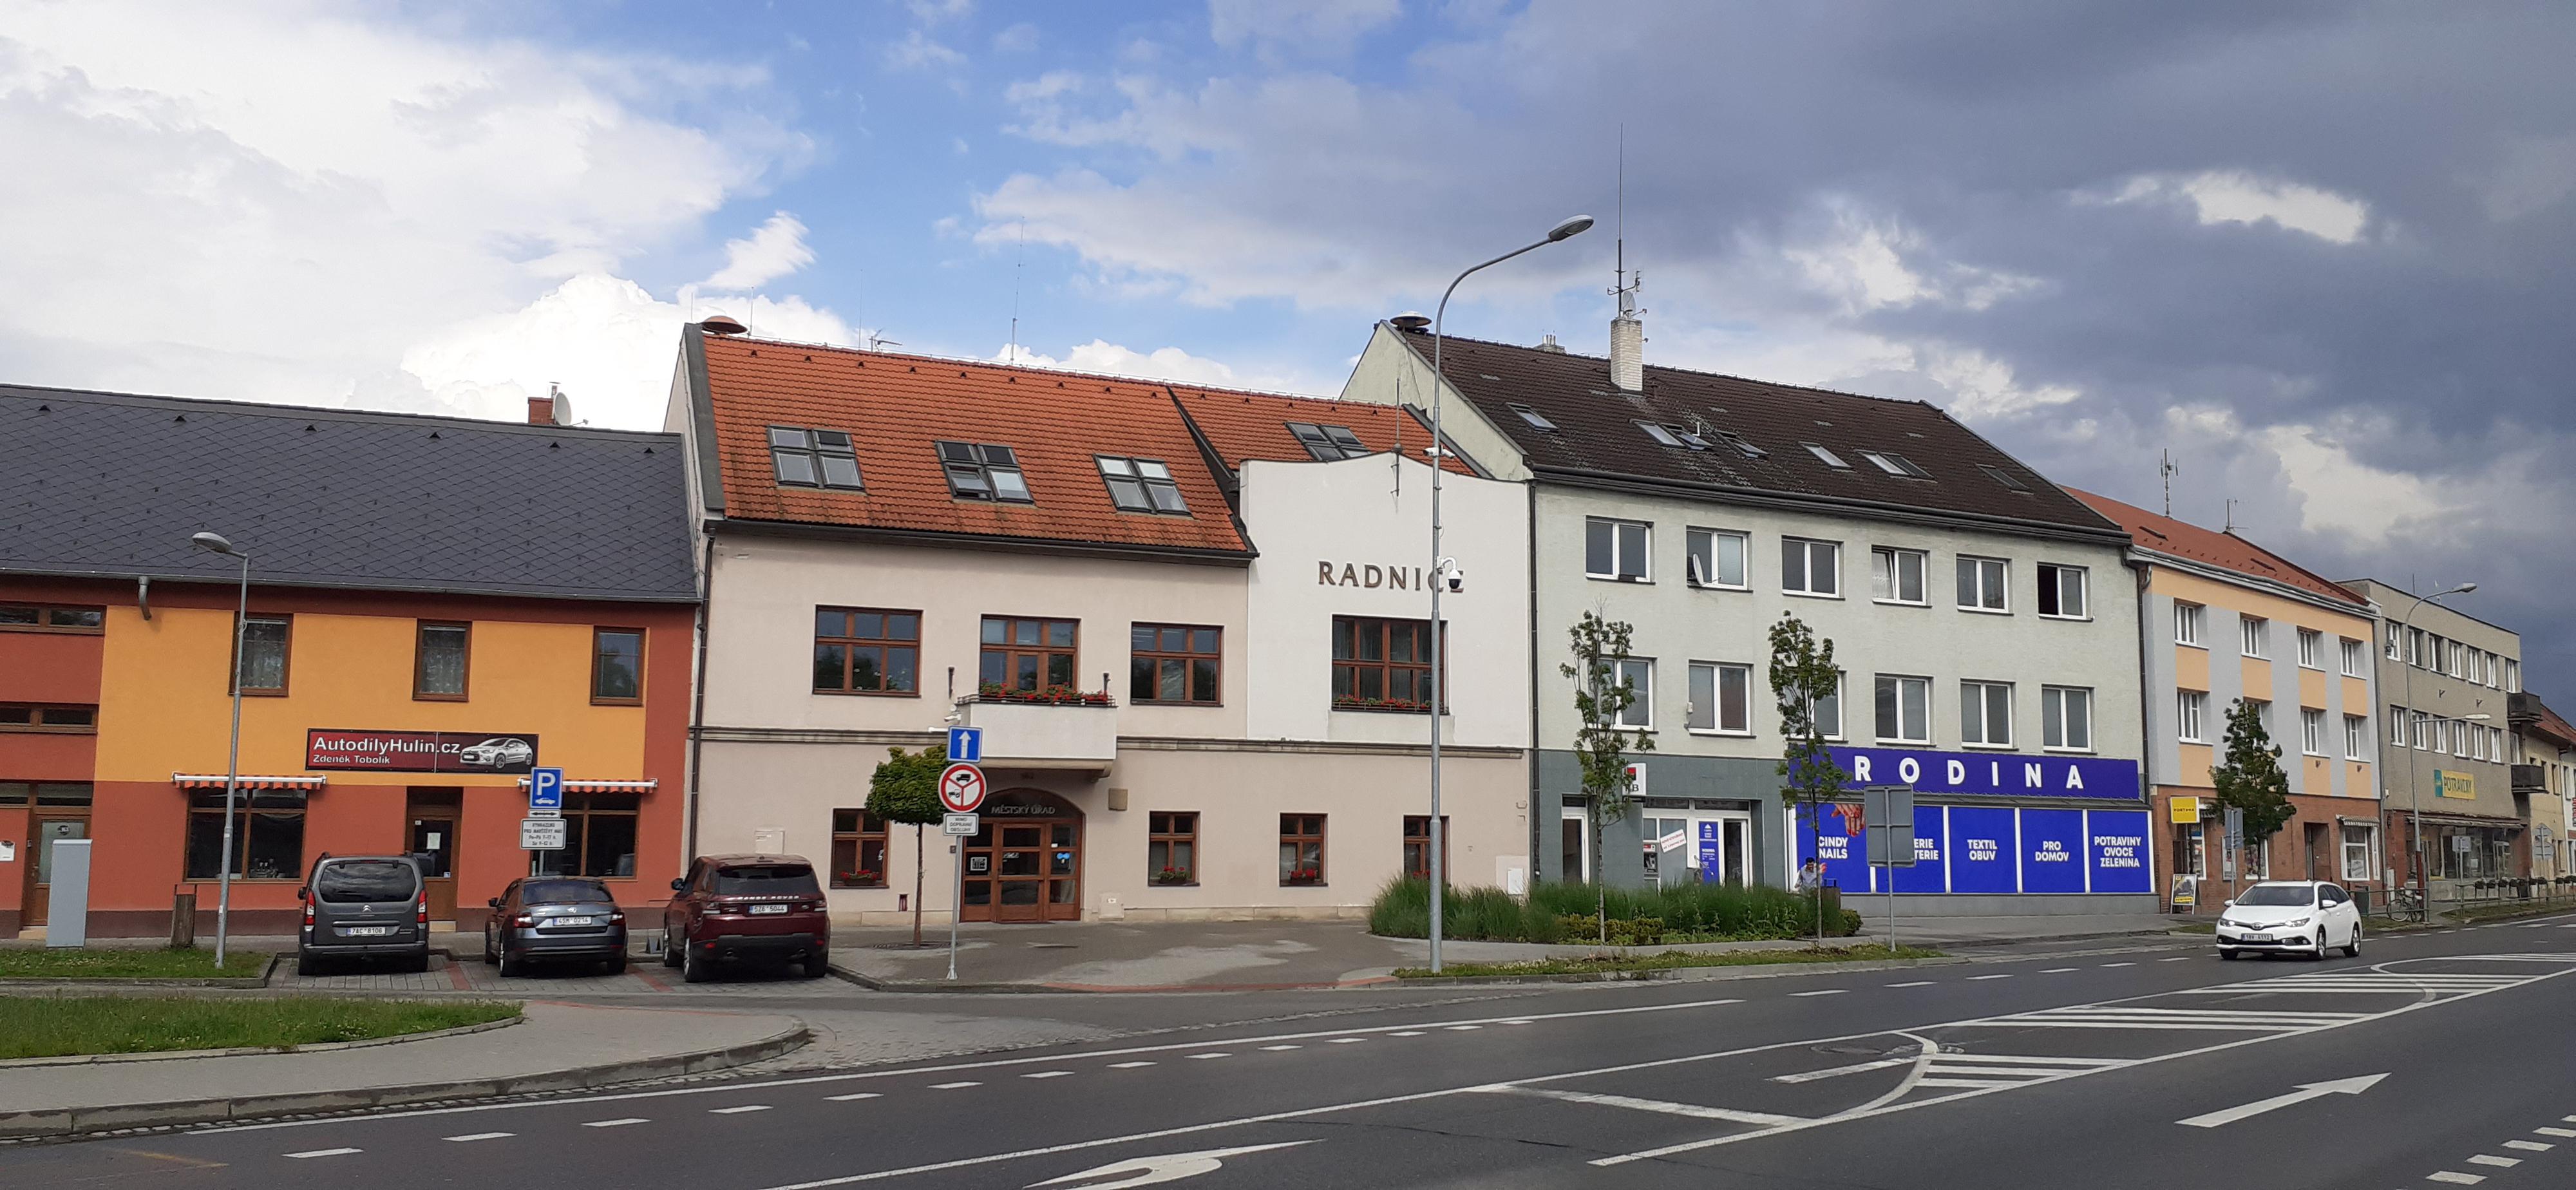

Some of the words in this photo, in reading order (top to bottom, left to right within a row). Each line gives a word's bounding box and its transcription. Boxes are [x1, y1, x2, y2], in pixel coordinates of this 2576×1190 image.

[313, 737, 460, 754] AutodilyHulin.cz
[1854, 755, 2084, 789] RODINA
[537, 773, 556, 796] P
[1819, 836, 1848, 847] CINDY
[1967, 839, 1997, 849] TEXTIL
[2043, 841, 2061, 851] PRO
[2094, 836, 2141, 846] POTRAVINY
[1819, 848, 1848, 858] NAILS
[1969, 850, 1996, 860] OBUV
[2035, 851, 2069, 862] DOMOV
[2104, 847, 2133, 856] OVOCE
[2100, 857, 2140, 867] ZELENINA
